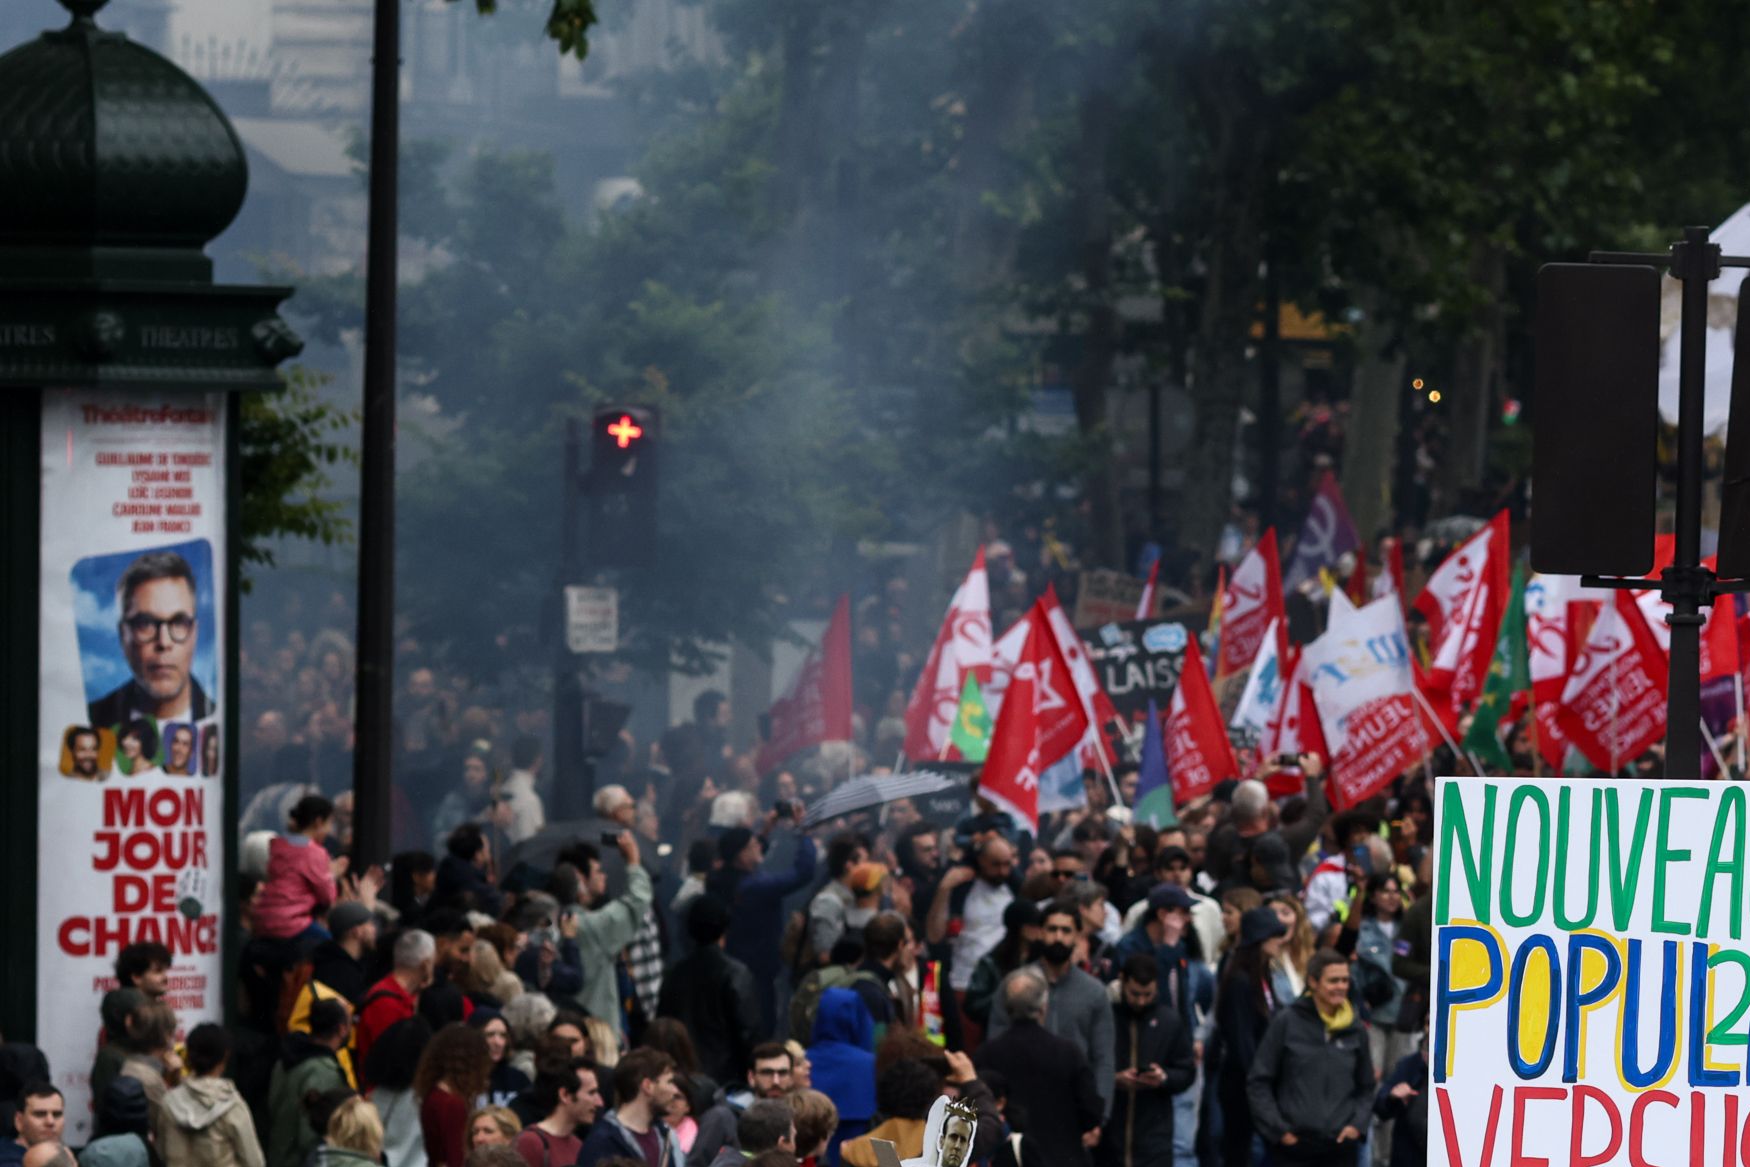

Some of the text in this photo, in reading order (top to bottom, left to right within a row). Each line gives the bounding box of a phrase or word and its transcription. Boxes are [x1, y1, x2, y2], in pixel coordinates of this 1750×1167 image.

[103, 788, 204, 827] MON
[92, 832, 208, 871] JOUR
[113, 875, 177, 913] DE
[57, 915, 218, 956] CHANCE
